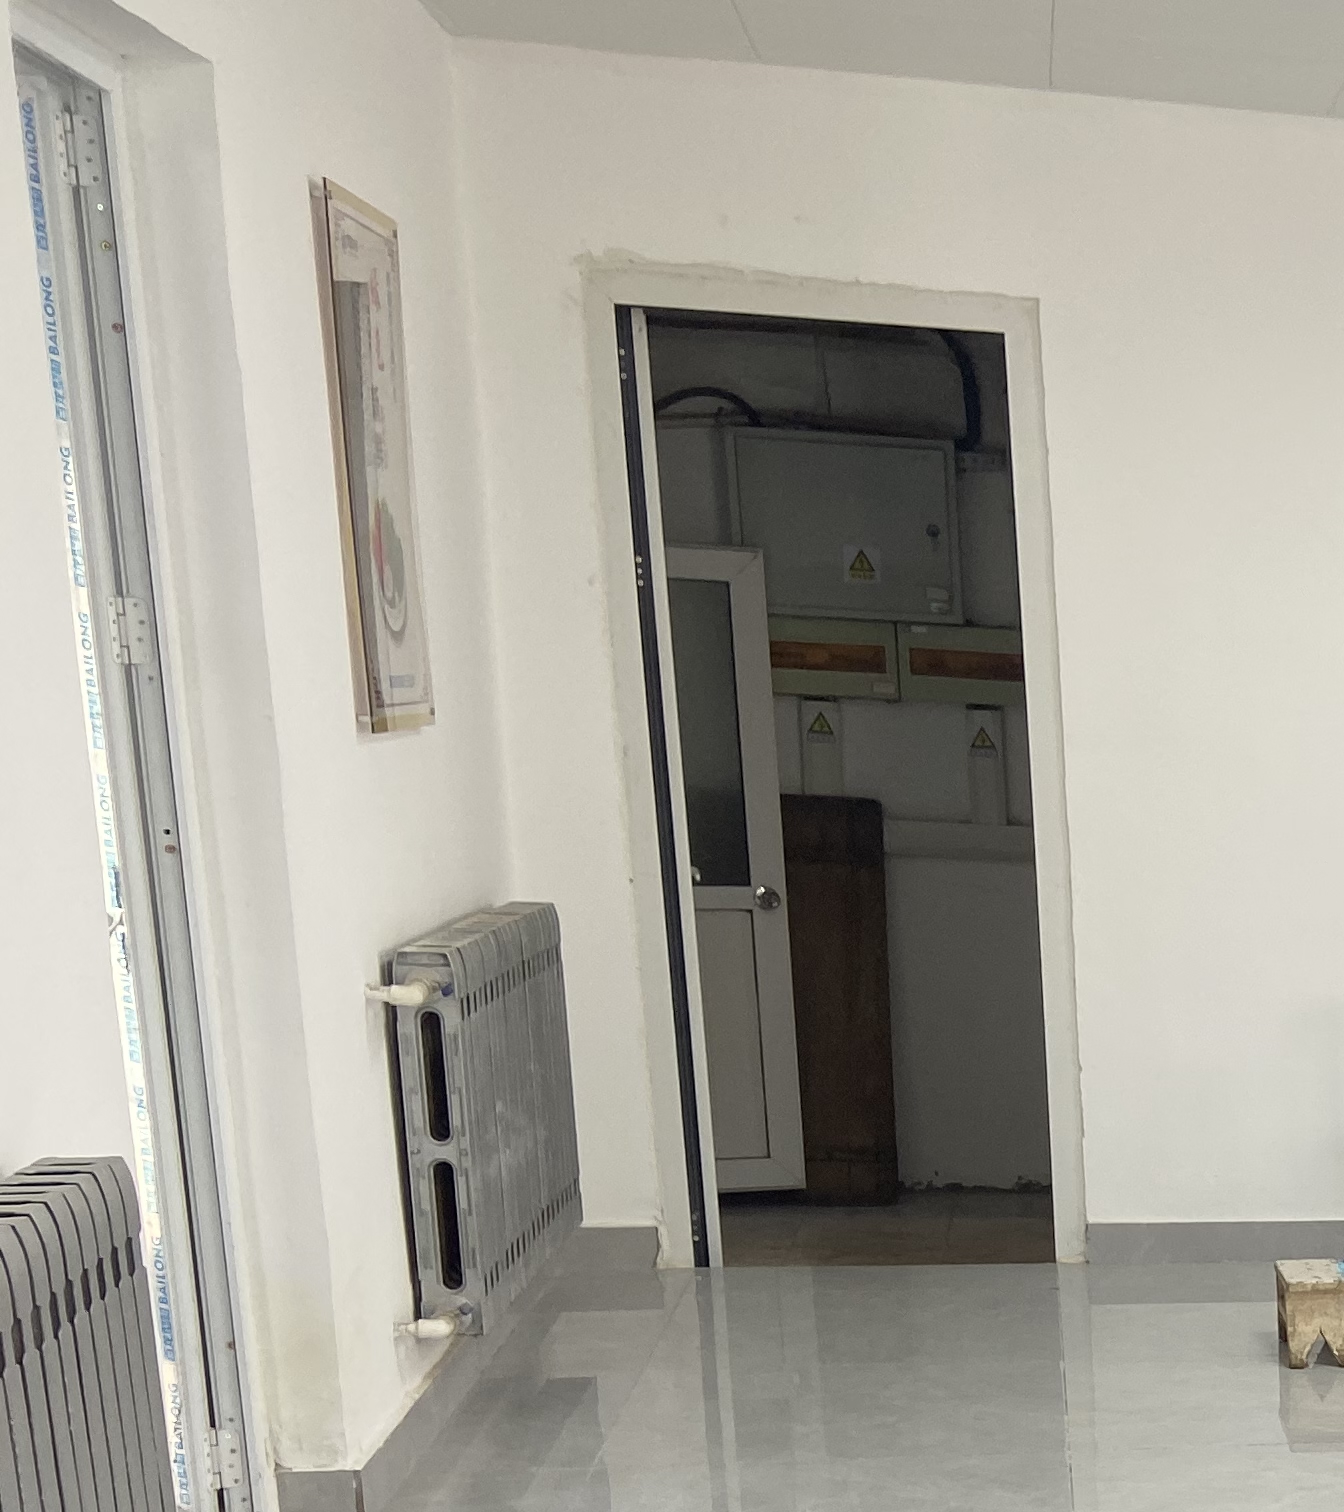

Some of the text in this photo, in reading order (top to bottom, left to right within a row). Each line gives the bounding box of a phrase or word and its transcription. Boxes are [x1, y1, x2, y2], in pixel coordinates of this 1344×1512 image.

[21, 101, 41, 184] BAILONG
[40, 276, 60, 356] BAILONG
[59, 446, 78, 524] BAILONG
[78, 612, 96, 688] BAILONG
[150, 1235, 169, 1306] BAILONG
